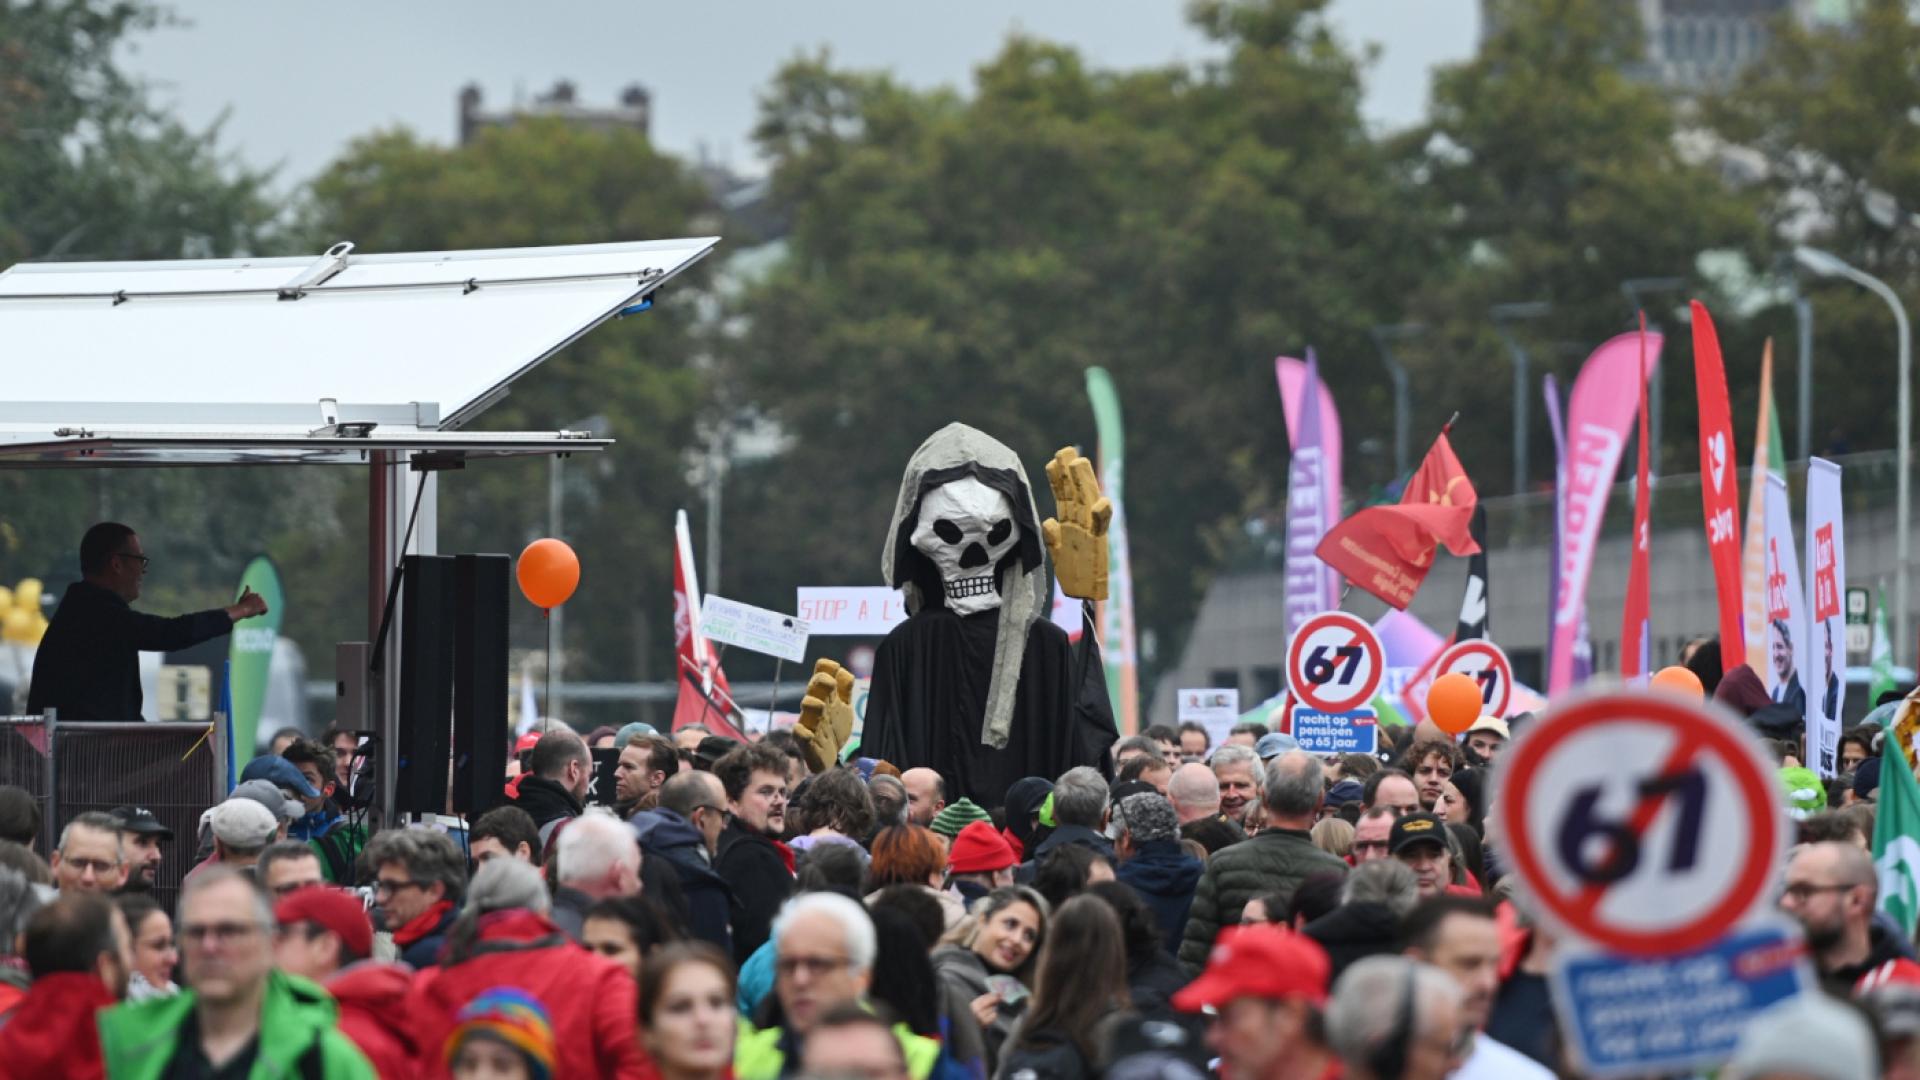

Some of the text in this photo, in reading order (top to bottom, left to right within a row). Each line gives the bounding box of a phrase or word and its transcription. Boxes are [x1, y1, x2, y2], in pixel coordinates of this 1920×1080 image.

[800, 599, 848, 621] STOP
[1304, 645, 1363, 685] 67
[1461, 669, 1498, 705] 7
[1299, 714, 1331, 725] recht
[1332, 716, 1349, 728] op
[1299, 737, 1358, 749] op 65 jaar
[1557, 768, 1709, 885] 67
